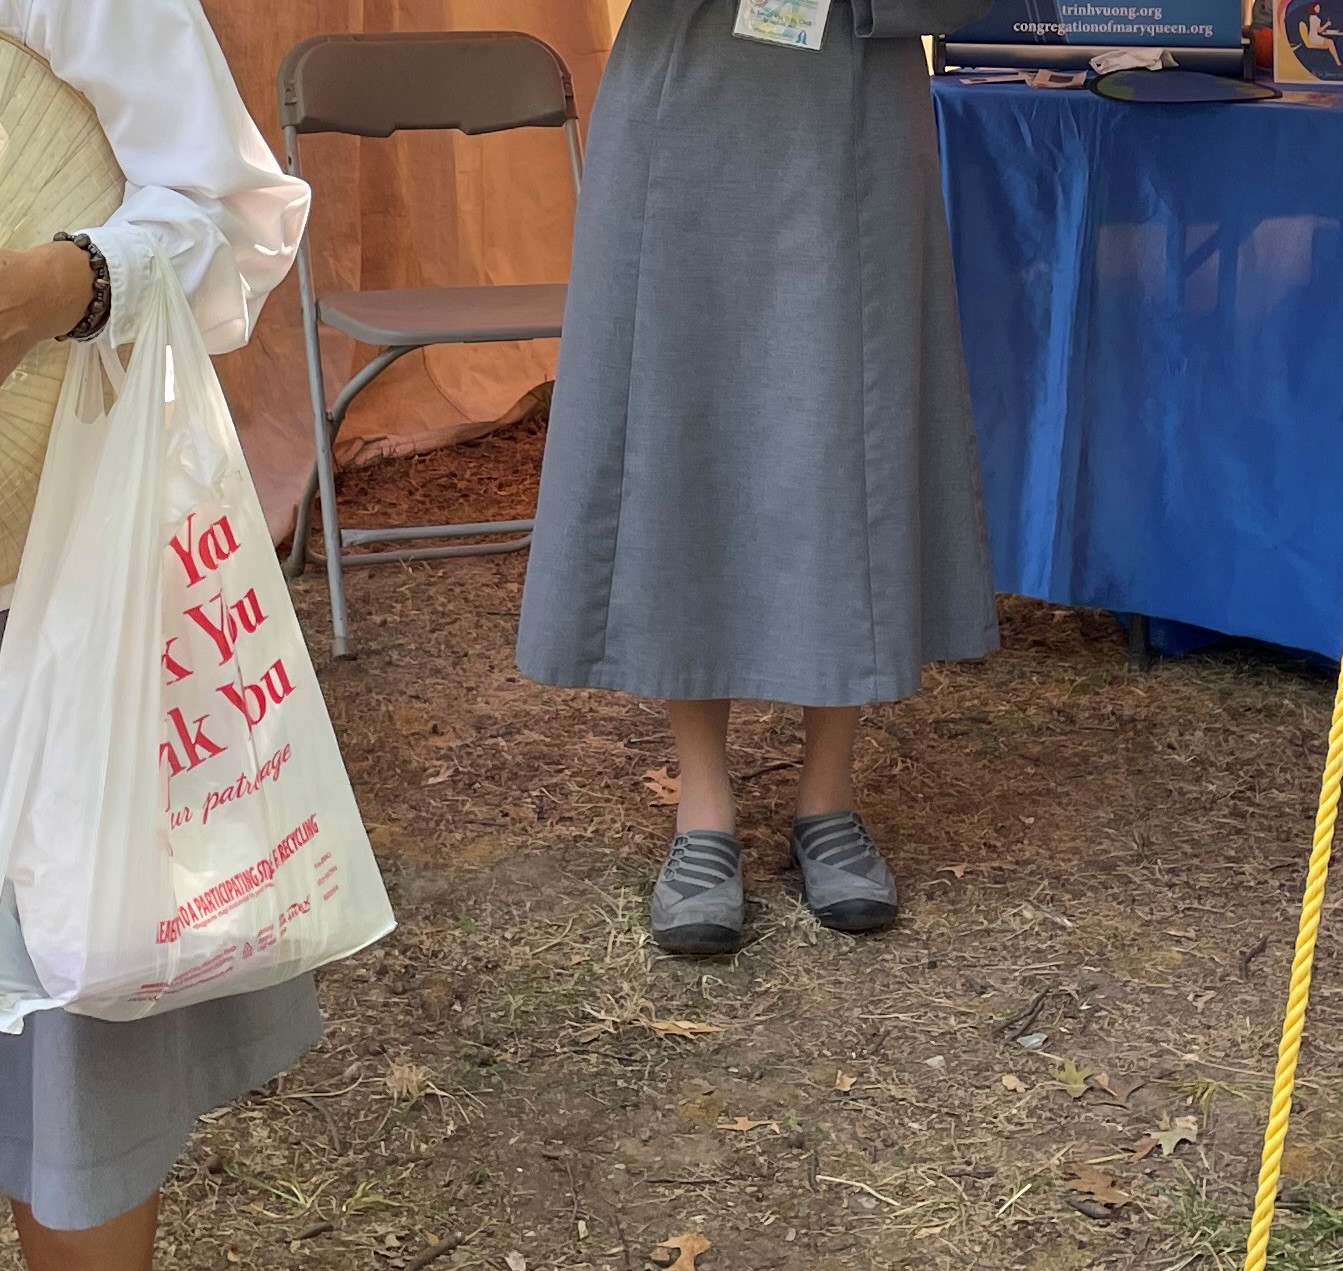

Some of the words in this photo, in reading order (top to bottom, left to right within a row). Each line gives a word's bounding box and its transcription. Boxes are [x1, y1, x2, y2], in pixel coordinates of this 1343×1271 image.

[1062, 3, 1163, 19] trinhvuong.org
[1013, 20, 1214, 37] congregationofmaryqueen.org
[193, 866, 260, 916] PARTICIPATING
[278, 812, 320, 864] RECYCLING
